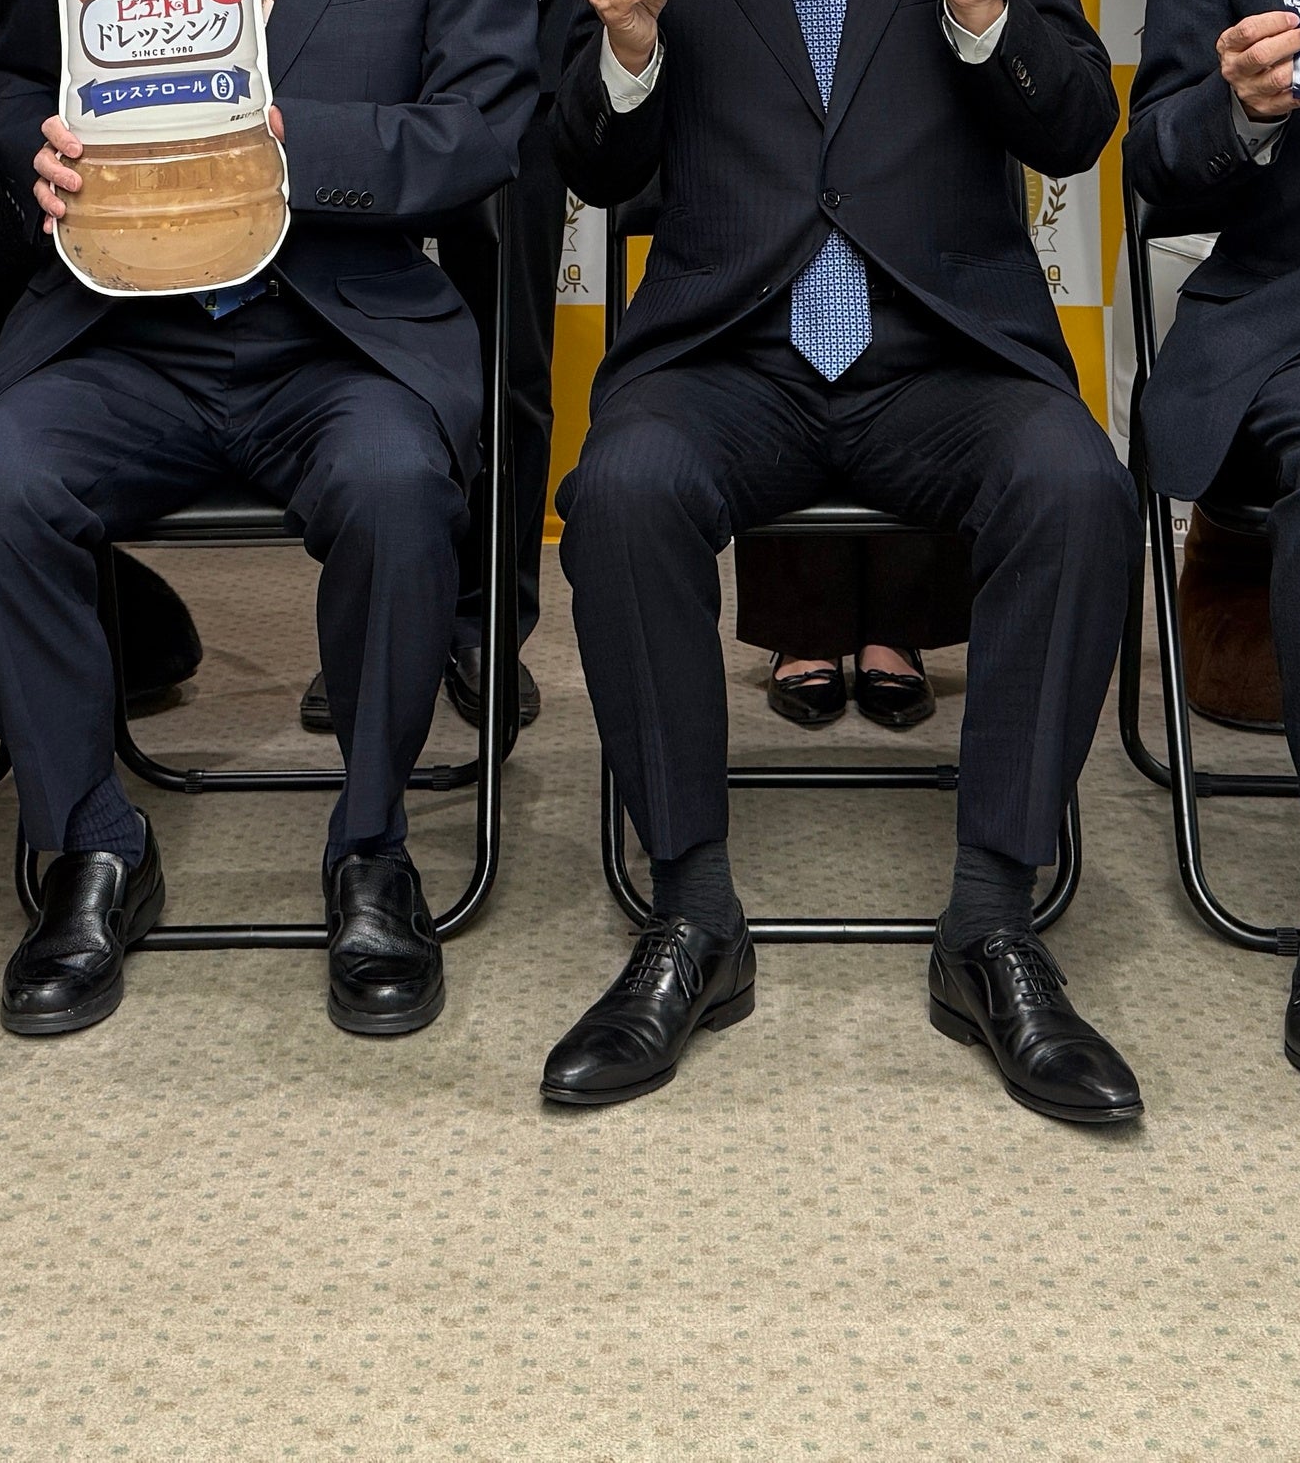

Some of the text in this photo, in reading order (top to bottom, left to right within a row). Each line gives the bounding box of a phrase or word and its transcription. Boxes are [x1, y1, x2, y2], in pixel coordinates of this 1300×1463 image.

[96, 10, 230, 51] ドレッシング
[132, 46, 194, 58] SINCE 1980
[102, 79, 207, 105] コレステロール
